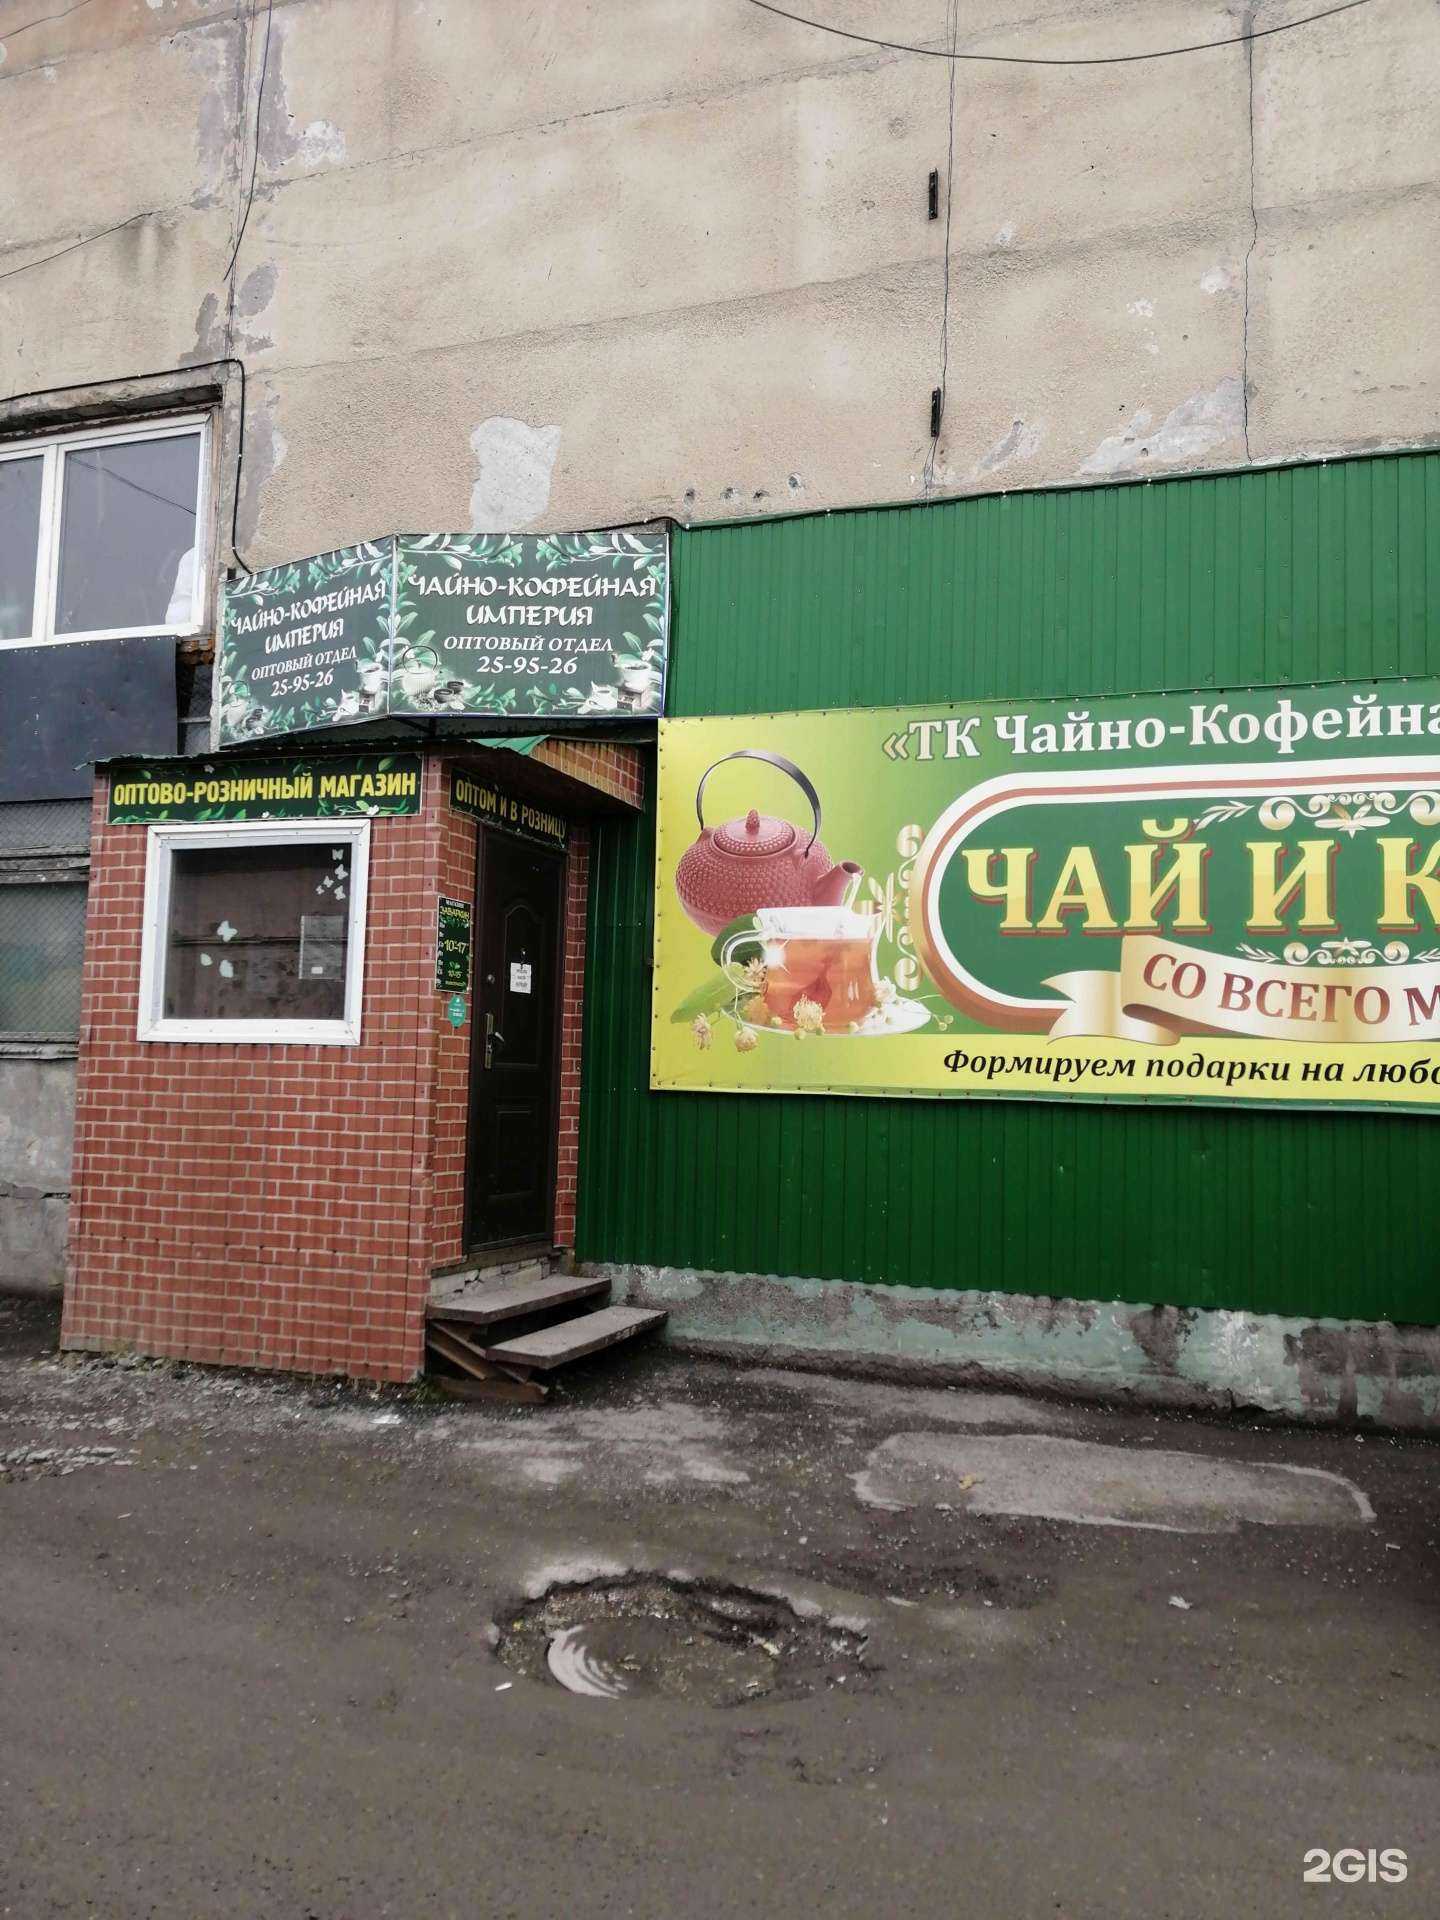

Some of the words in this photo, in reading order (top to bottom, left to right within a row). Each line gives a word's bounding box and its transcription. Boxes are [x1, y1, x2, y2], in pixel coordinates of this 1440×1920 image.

[407, 575, 656, 598] ЧАЙНО-КОФЕЙНАЯ
[232, 580, 386, 635] ЧАЙНО-КОФЕЙНАЯ
[466, 605, 593, 626] ИМПЕРИЯ
[264, 618, 344, 655] ИМПЕРИЯ
[444, 635, 544, 651] ОПТОВЫЙ
[549, 638, 613, 652] ОТДЕЛ
[251, 655, 313, 681] ОПТОВЫЙ
[315, 646, 357, 669] ОТДЕЛ
[477, 657, 577, 675] 25-95-26
[271, 670, 334, 697] 25-95-26
[882, 717, 982, 761] «ТК
[114, 772, 313, 805] ОПТОВО-РОЗНИЧНЫЙ
[320, 772, 416, 798] МАГАЗИН
[456, 779, 496, 812] ОПТОМ
[500, 796, 507, 817] И
[510, 801, 518, 821] В
[521, 804, 567, 839] РОЗНИЦУ
[962, 818, 1210, 932] ЧАЙ
[1245, 838, 1337, 930] И
[1143, 952, 1207, 1000] СО
[1218, 972, 1390, 1026] ВСЕГО
[943, 1048, 1136, 1083] Формируем
[1145, 1052, 1290, 1086] подарки
[1301, 1062, 1344, 1082] на
